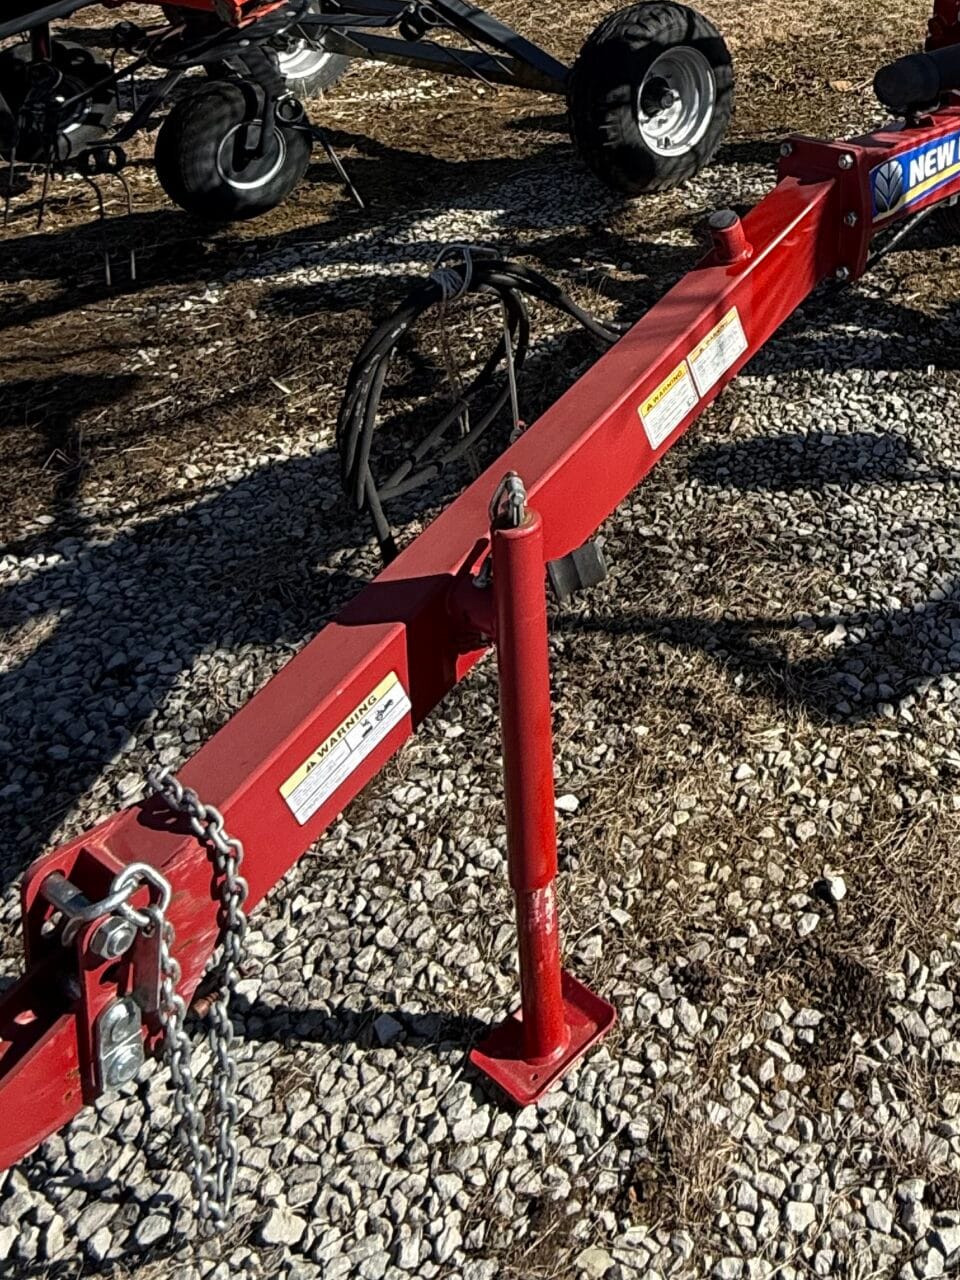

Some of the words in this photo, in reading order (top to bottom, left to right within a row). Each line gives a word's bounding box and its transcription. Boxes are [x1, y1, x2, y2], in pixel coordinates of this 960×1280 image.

[909, 140, 956, 188] NEW
[652, 370, 684, 403] WARNING
[317, 695, 378, 758] WARNING
